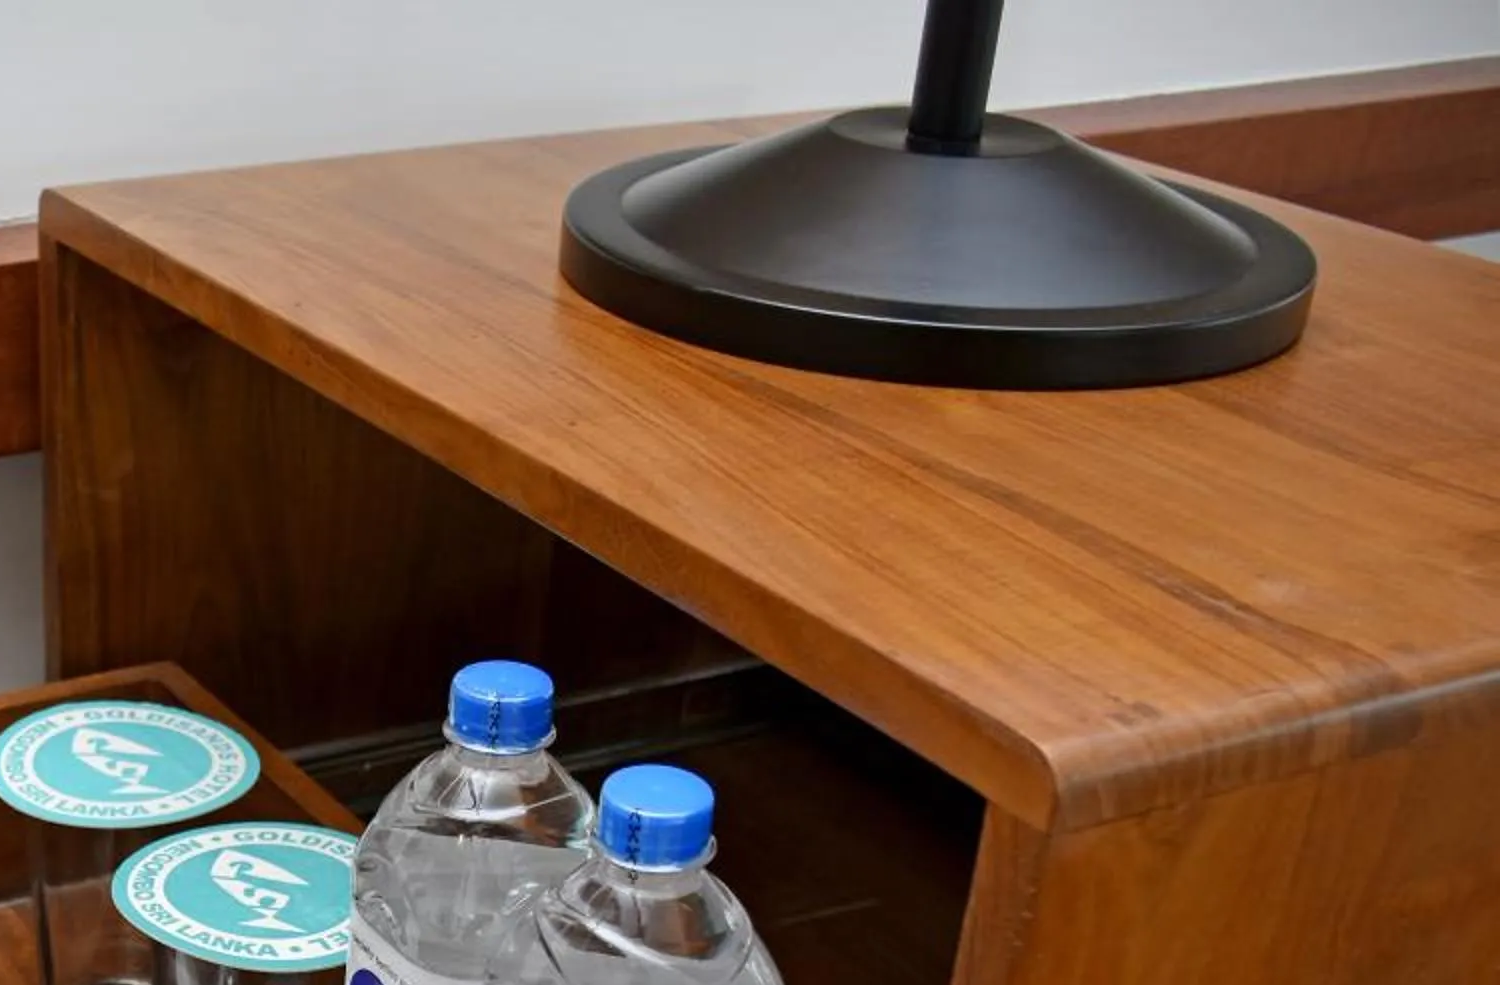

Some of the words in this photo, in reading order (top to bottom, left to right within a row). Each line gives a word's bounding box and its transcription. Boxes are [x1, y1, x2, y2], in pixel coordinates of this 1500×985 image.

[20, 783, 52, 806] SRI
[55, 801, 150, 818] LANKA
[176, 763, 240, 803] HOTEL
[133, 839, 203, 901] NEGOMBO
[142, 903, 177, 925] SRI
[175, 924, 280, 957] LANKA
